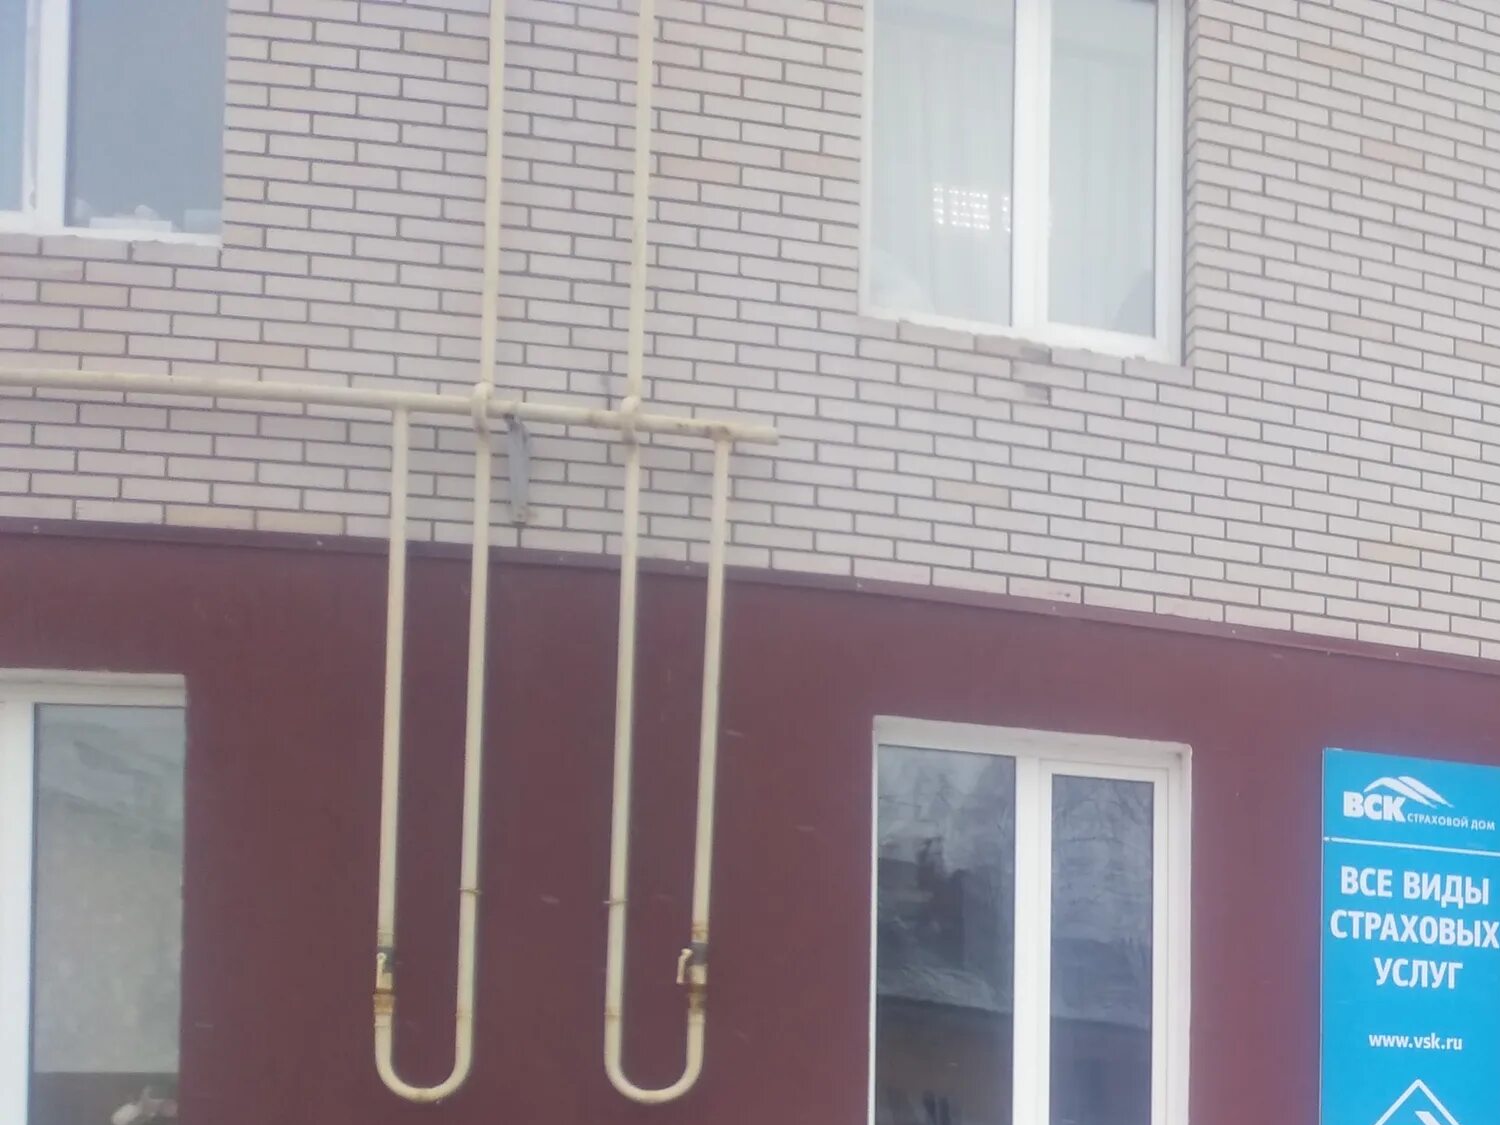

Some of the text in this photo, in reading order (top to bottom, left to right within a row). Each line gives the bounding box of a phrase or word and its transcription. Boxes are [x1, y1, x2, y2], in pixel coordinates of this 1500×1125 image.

[1343, 791, 1495, 831] ВСК СТРАХОВОЙ ДОМ
[1341, 865, 1489, 909] ВСЕ ВИДЫ
[1330, 909, 1500, 949] СТРАХОВЫХ
[1373, 957, 1463, 989] УСЛУГ
[1368, 1032, 1463, 1050] www.vsk.ru
